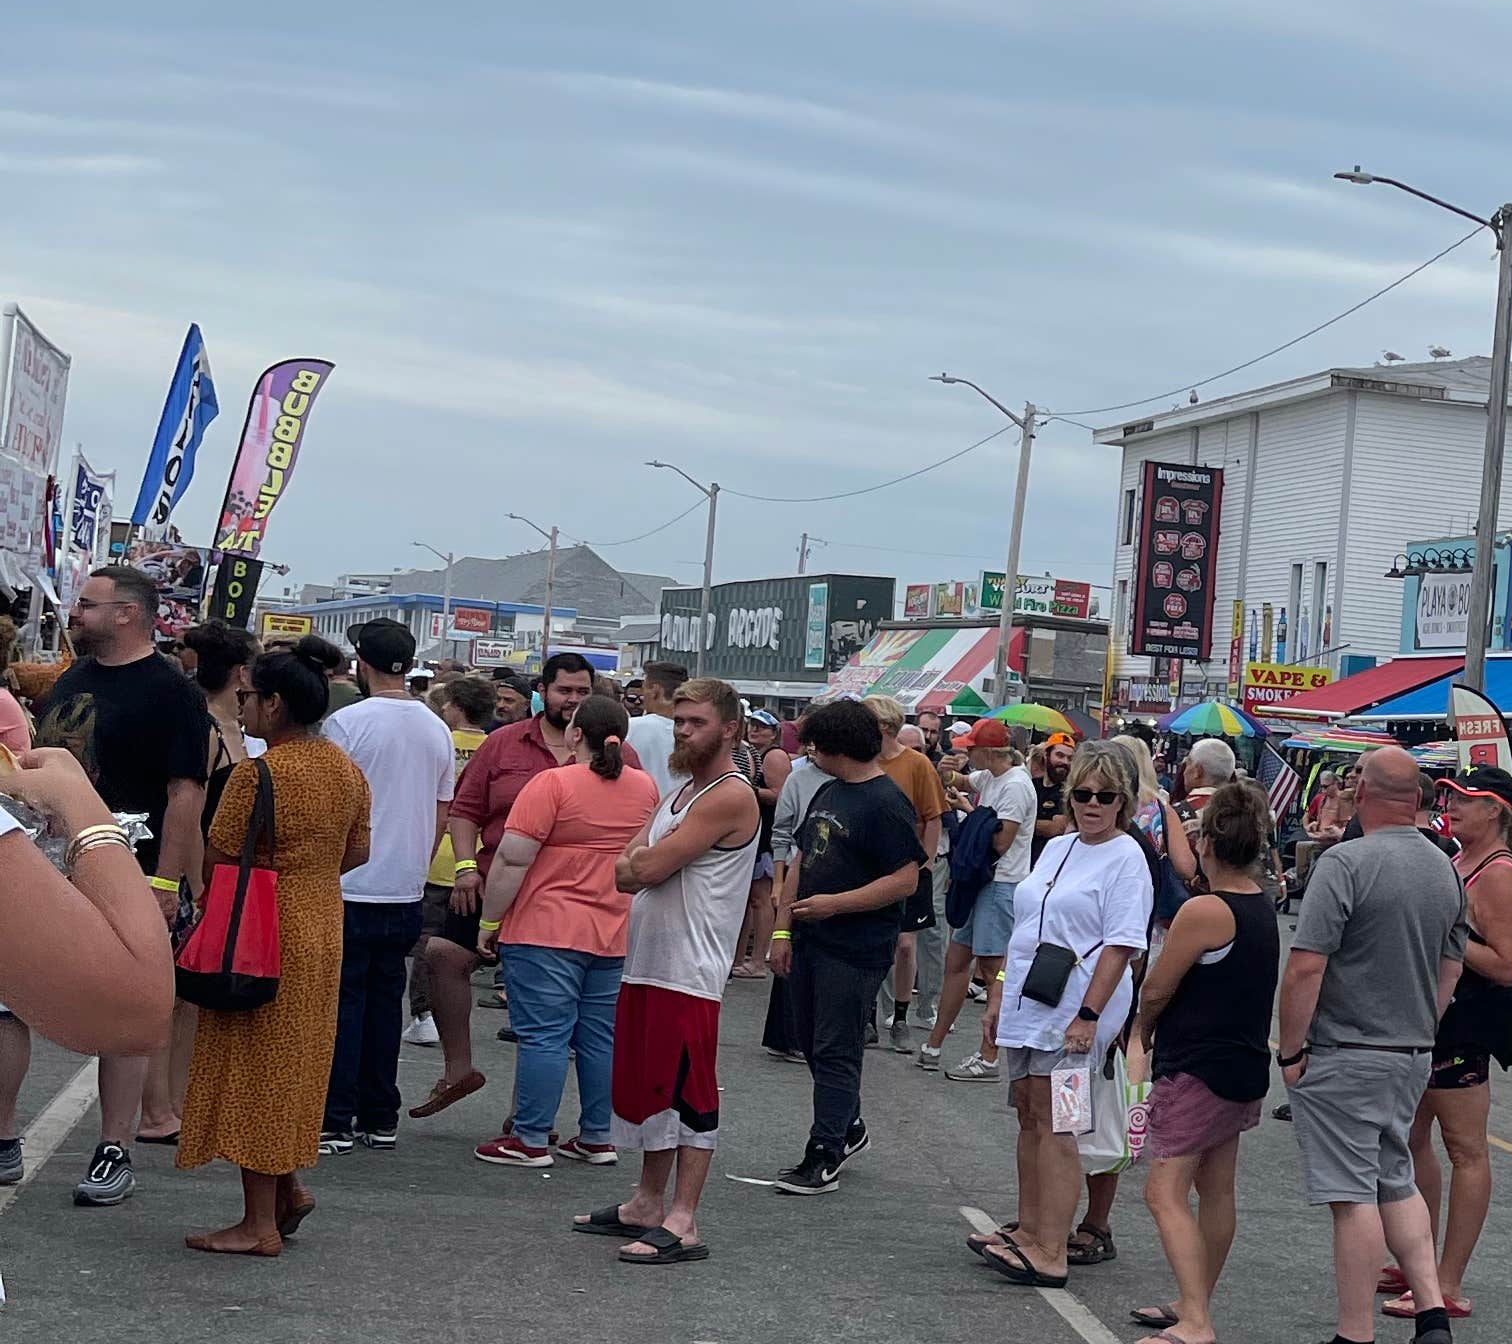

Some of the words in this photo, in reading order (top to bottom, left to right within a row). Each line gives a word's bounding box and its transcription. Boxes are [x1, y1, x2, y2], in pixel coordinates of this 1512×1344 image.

[1049, 600, 1079, 615] Pizza
[1420, 585, 1447, 618] PLAYA
[727, 606, 784, 652] ARCADE
[1250, 669, 1305, 687] VAPE
[1310, 674, 1327, 687] &
